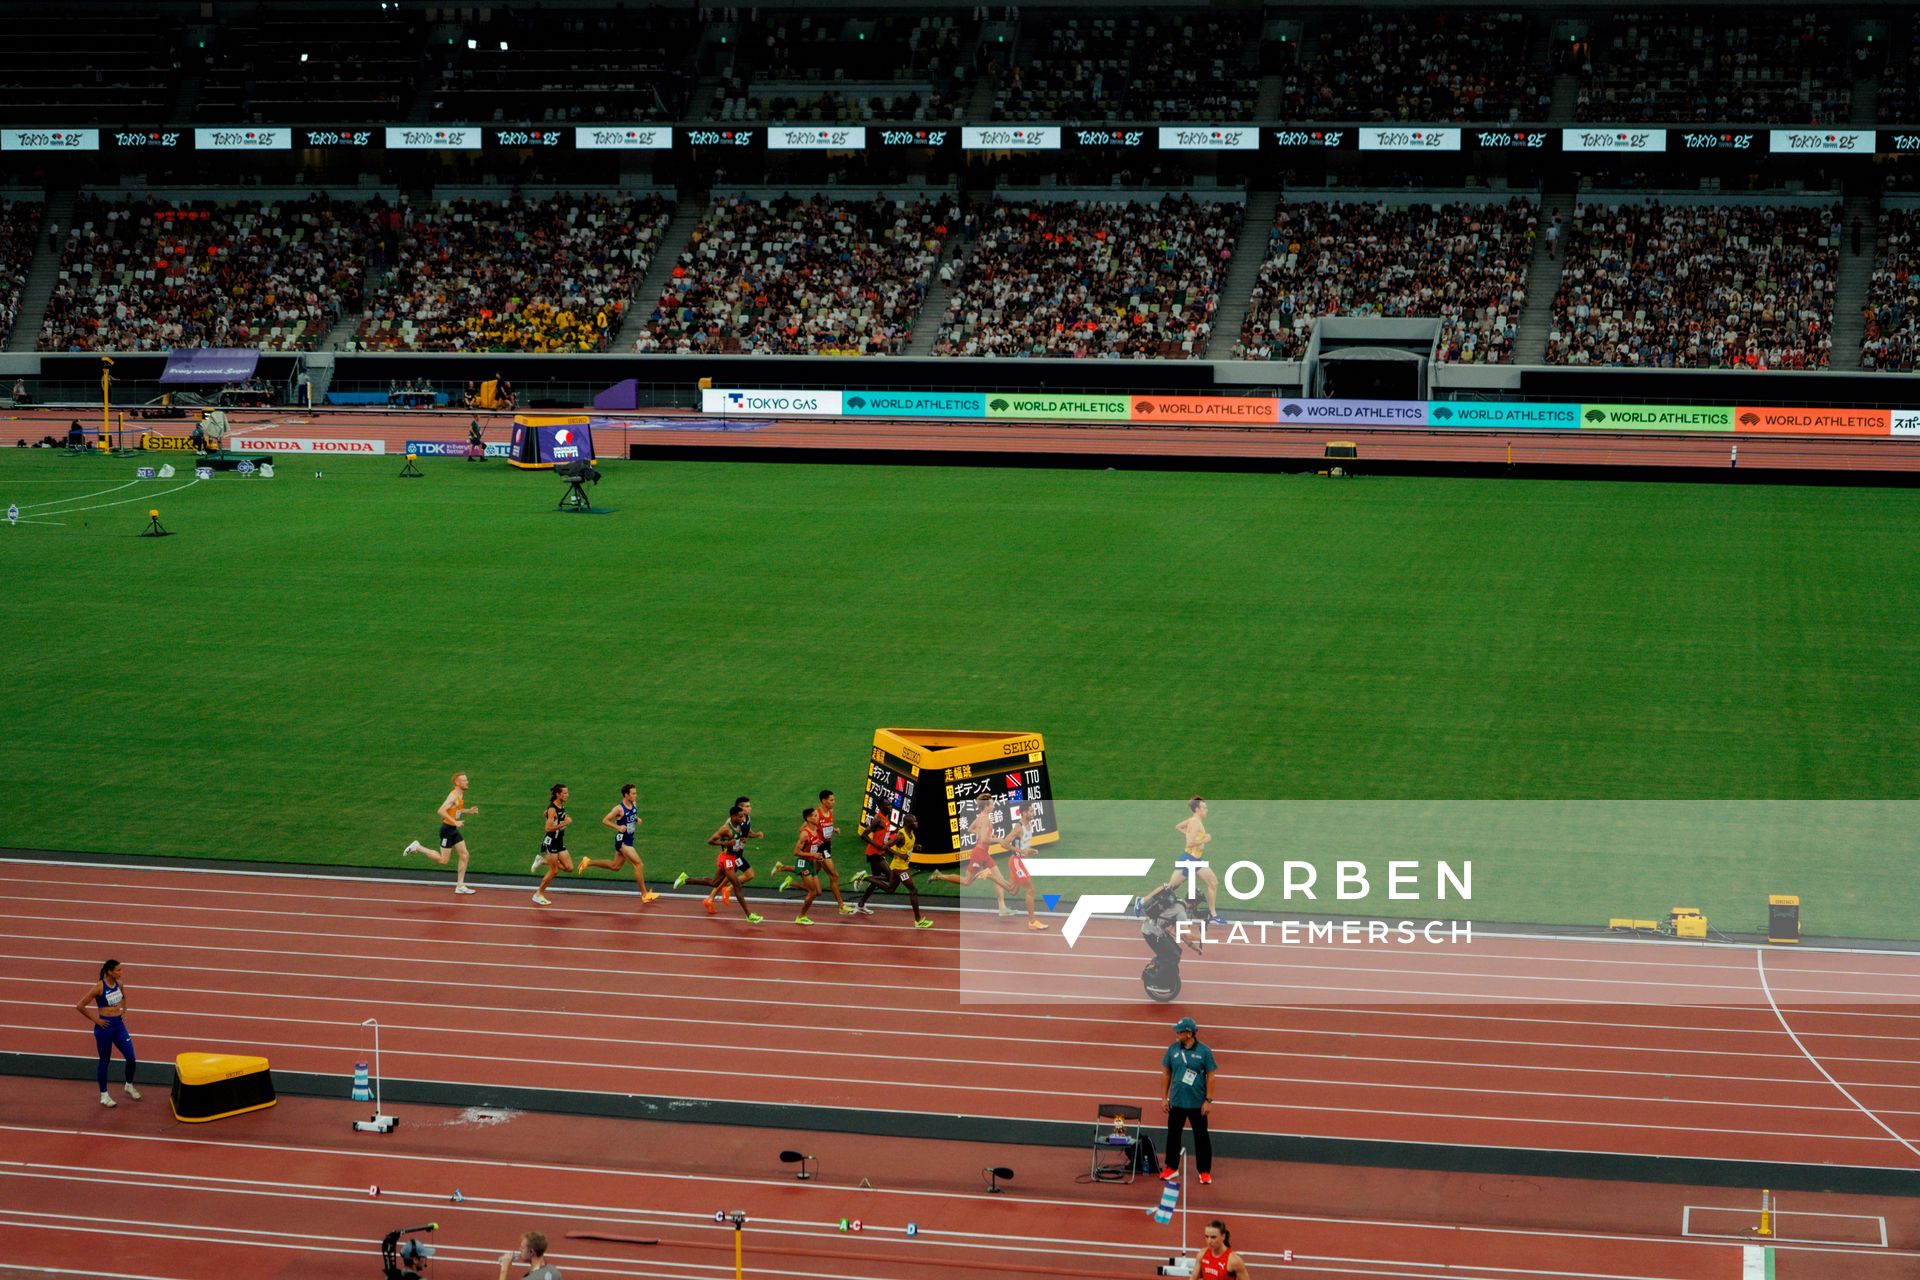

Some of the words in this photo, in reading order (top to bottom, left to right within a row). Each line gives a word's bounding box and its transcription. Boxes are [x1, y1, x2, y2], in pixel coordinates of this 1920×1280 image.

[18, 133, 49, 147] TOKYO
[65, 133, 83, 147] 25
[114, 132, 146, 146] TOKYO
[162, 132, 180, 146] 25
[212, 132, 241, 146] TOKYO
[258, 132, 276, 146] 25
[307, 132, 338, 146] TOKYO
[353, 132, 371, 146] 25
[403, 132, 433, 146] TOKYO
[449, 132, 466, 146] 25
[497, 132, 528, 146] TOKYO
[543, 132, 561, 146] 25
[592, 132, 624, 146] TOKYO
[639, 132, 656, 146] 25
[687, 132, 719, 146] TOKYO
[735, 132, 753, 146] 25
[785, 132, 815, 146] TOKYO
[832, 132, 849, 146] 25
[881, 131, 913, 146] TOKYO
[928, 131, 946, 146] 25
[979, 131, 1010, 145] TOKYO
[1026, 131, 1044, 145] 25
[1076, 131, 1108, 145] TOKYO
[1125, 131, 1144, 145] 25
[1177, 131, 1207, 145] TOKYO
[1225, 131, 1242, 145] 25
[1274, 131, 1308, 146] TOKYO
[1324, 131, 1343, 146] 25
[1377, 132, 1409, 146] TOKYO
[1426, 132, 1444, 146] 25
[1476, 132, 1510, 147] TOKYO
[1527, 132, 1546, 147] 25
[1580, 132, 1613, 147] TOKYO
[1630, 132, 1649, 147] 25
[1681, 133, 1717, 149] TOKYO
[1734, 133, 1753, 149] 25
[1787, 135, 1821, 149] TOKYO
[1840, 135, 1858, 149] 25
[747, 398, 789, 410] TOKYO
[793, 398, 818, 411] GAS
[870, 399, 912, 409] WORLD
[915, 400, 980, 411] ATHLETICS
[1013, 401, 1057, 412] WORLD
[1059, 402, 1125, 413] ATHLETICS
[1159, 404, 1202, 414] WORLD
[1205, 404, 1272, 416] ATHLETICS
[1307, 406, 1352, 417] WORLD
[1355, 407, 1422, 419] ATHLETICS
[1458, 409, 1503, 420] WORLD
[1506, 410, 1574, 422] ATHLETICS
[1610, 412, 1656, 423] WORLD
[1659, 413, 1728, 425] ATHLETICS
[1765, 415, 1811, 426] WORLD
[1815, 416, 1885, 428] ATHLETICS
[1894, 416, 1920, 428] スポ
[149, 436, 197, 450] SEIK
[240, 441, 301, 450] HONDA
[312, 442, 374, 451] HONDA
[416, 443, 445, 454] TDK
[1003, 739, 1039, 756] SEIKO
[902, 747, 920, 764] SEIKO
[954, 778, 991, 797] ギテンズ
[1025, 769, 1040, 785] TTO
[1027, 785, 1042, 800] AUS
[1031, 818, 1045, 833] POL
[716, 1211, 724, 1221] C
[840, 1219, 848, 1231] A
[852, 1220, 861, 1231] C
[907, 1223, 916, 1234] D
